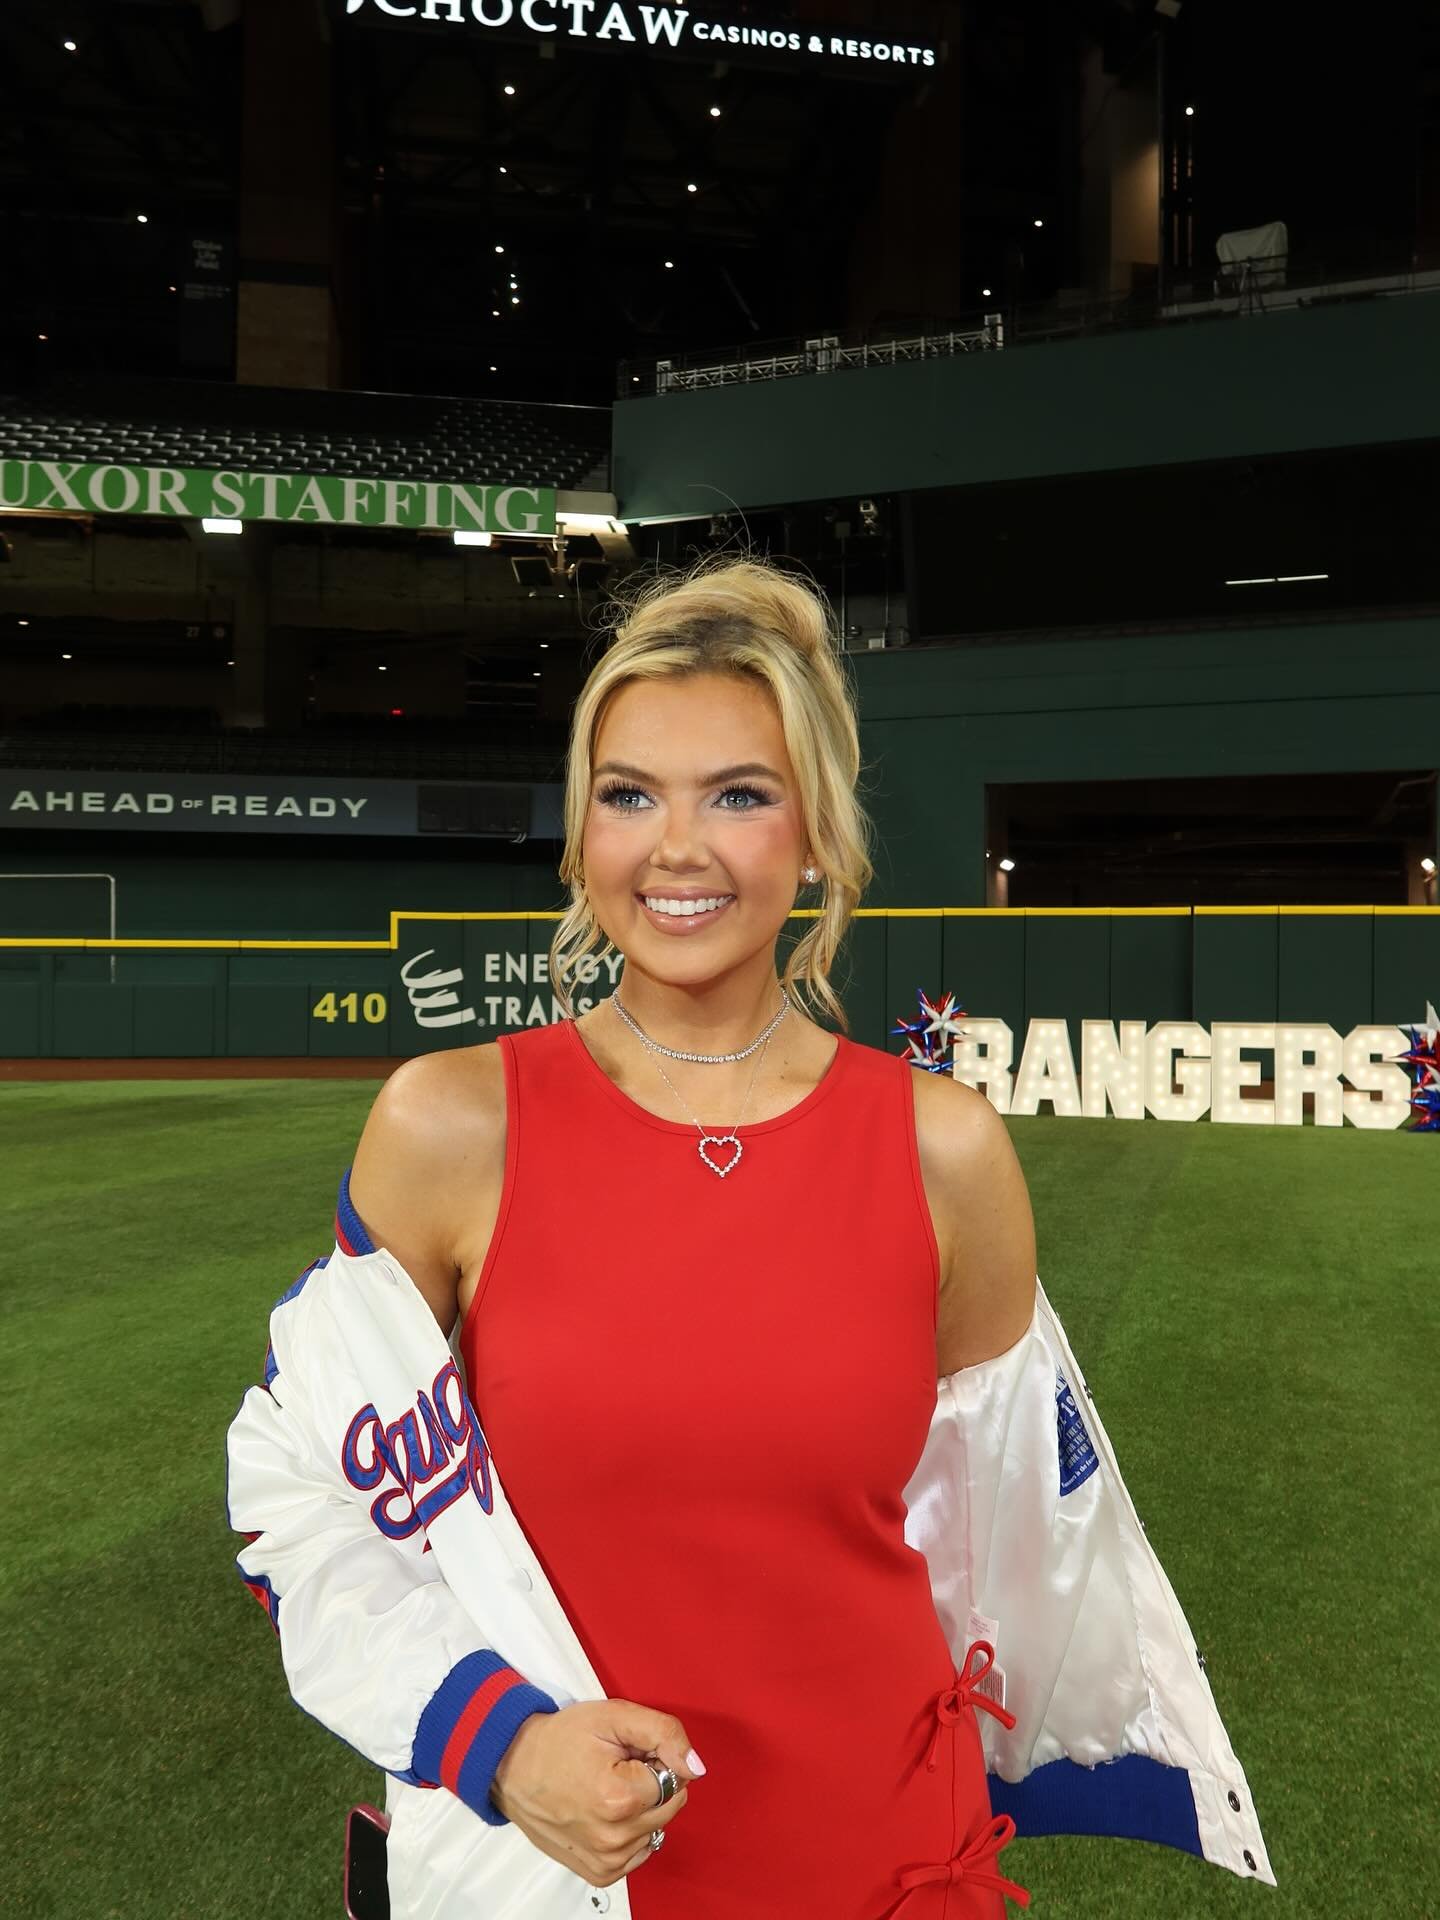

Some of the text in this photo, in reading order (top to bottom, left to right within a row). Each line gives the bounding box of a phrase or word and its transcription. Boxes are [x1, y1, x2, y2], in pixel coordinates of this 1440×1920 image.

[692, 22, 801, 51] CASINOS
[807, 36, 824, 53] &
[830, 37, 935, 66] RESORTS
[0, 459, 542, 533] UXOR STAFFING
[10, 790, 368, 818] AHEAD OF READY
[313, 992, 386, 1023] 410
[952, 1017, 1412, 1130] RANGERS
